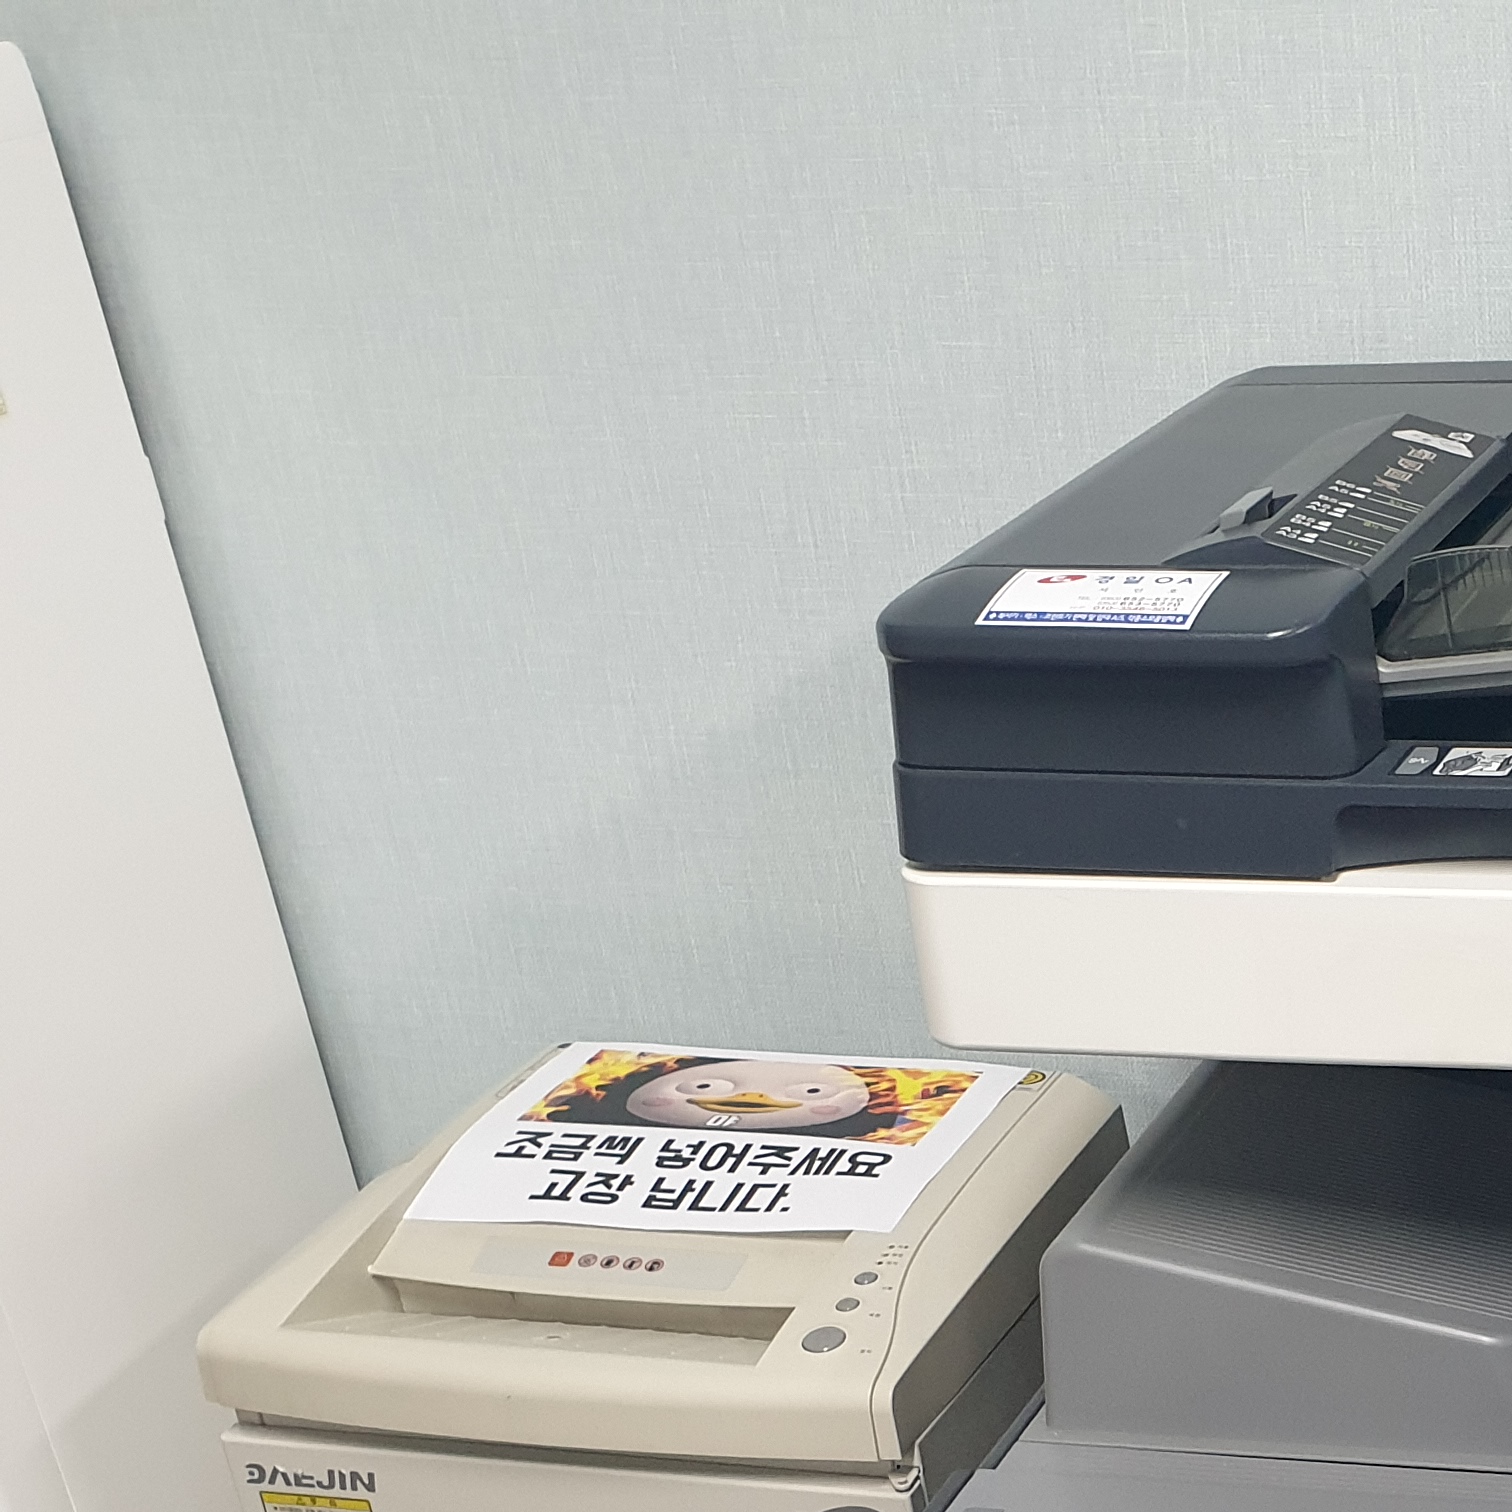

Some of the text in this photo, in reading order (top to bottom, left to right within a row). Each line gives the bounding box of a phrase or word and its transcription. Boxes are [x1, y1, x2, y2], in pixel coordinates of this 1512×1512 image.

[494, 1130, 893, 1179] 조금씩 넣어주세요
[529, 1168, 792, 1213] 고장 납니다.
[245, 1463, 376, 1492] DAEJIN
